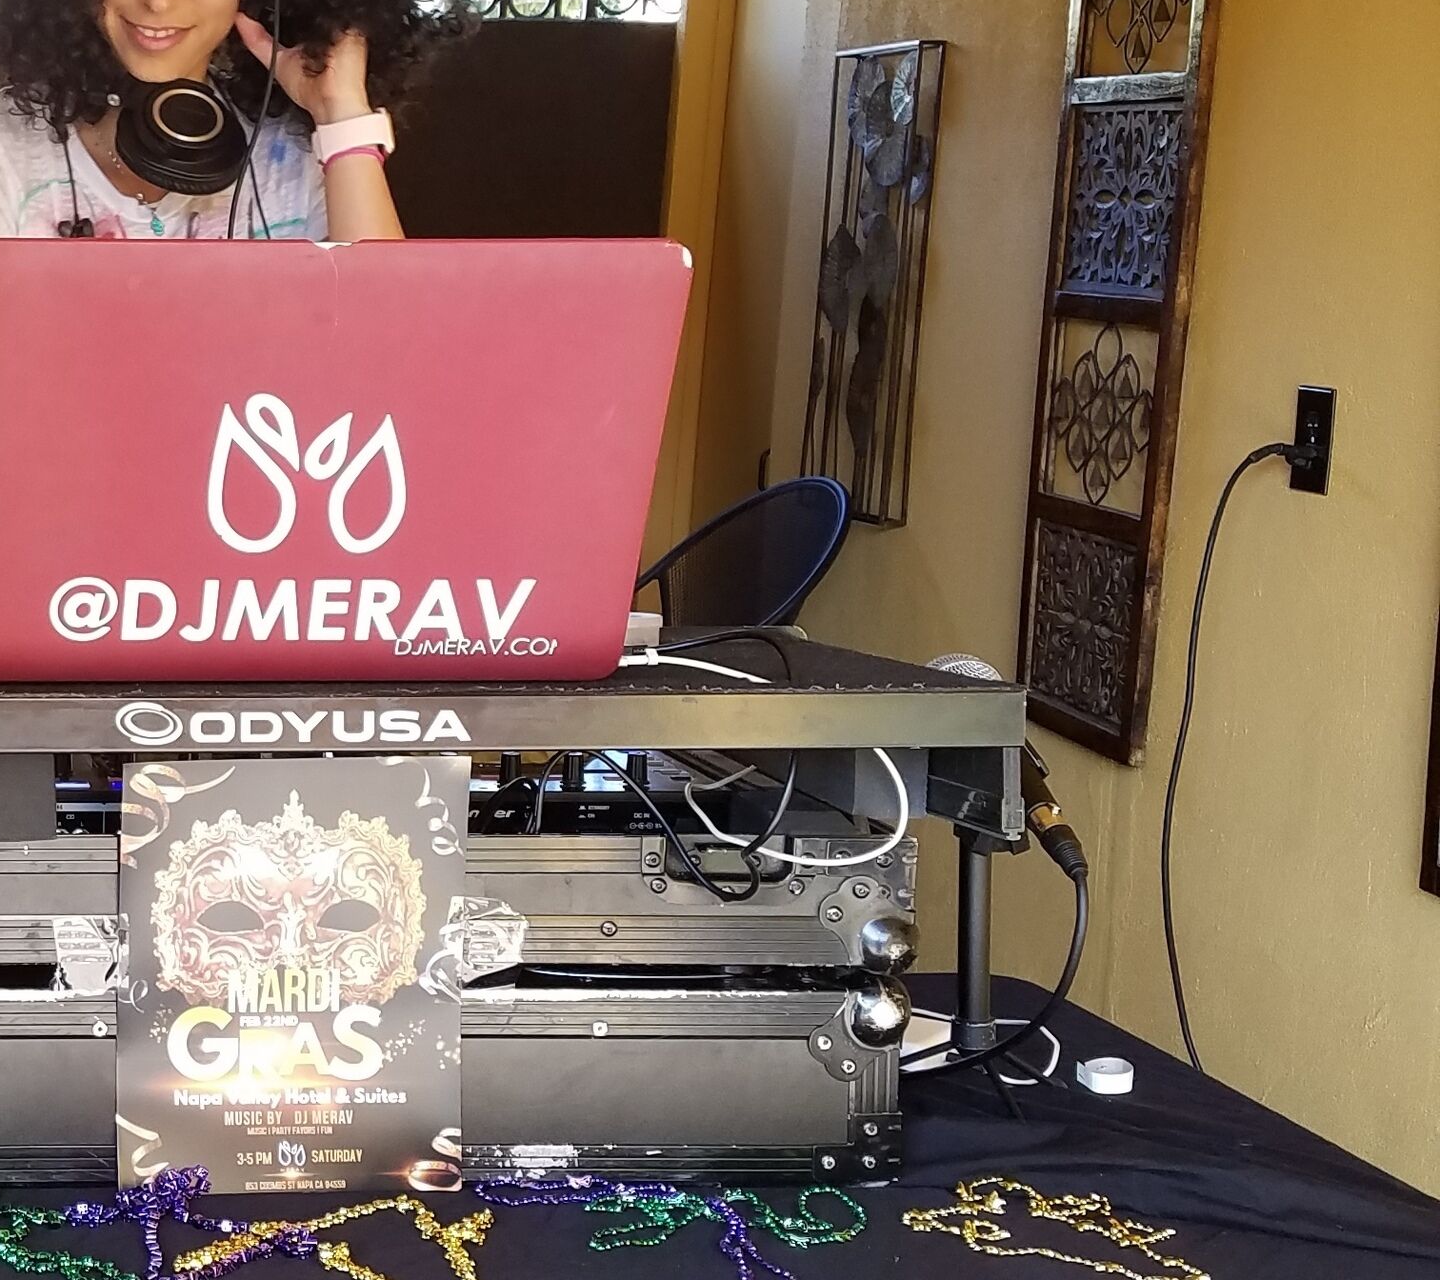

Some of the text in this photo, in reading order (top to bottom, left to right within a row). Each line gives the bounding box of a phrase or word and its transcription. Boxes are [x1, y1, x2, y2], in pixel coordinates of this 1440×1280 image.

[49, 576, 537, 642] @DJMERAV
[189, 708, 473, 744] ODYUSA
[228, 967, 341, 1013] MARDI
[167, 1003, 384, 1082] GRAS
[173, 1088, 223, 1110] Napa
[284, 1087, 332, 1105] Hotel
[353, 1086, 408, 1105] Suites
[224, 1109, 354, 1126] MUSIC BY DJ MERAV
[272, 1126, 291, 1136] PARTY
[236, 1148, 363, 1166] 3-5 PM SATURDAY
